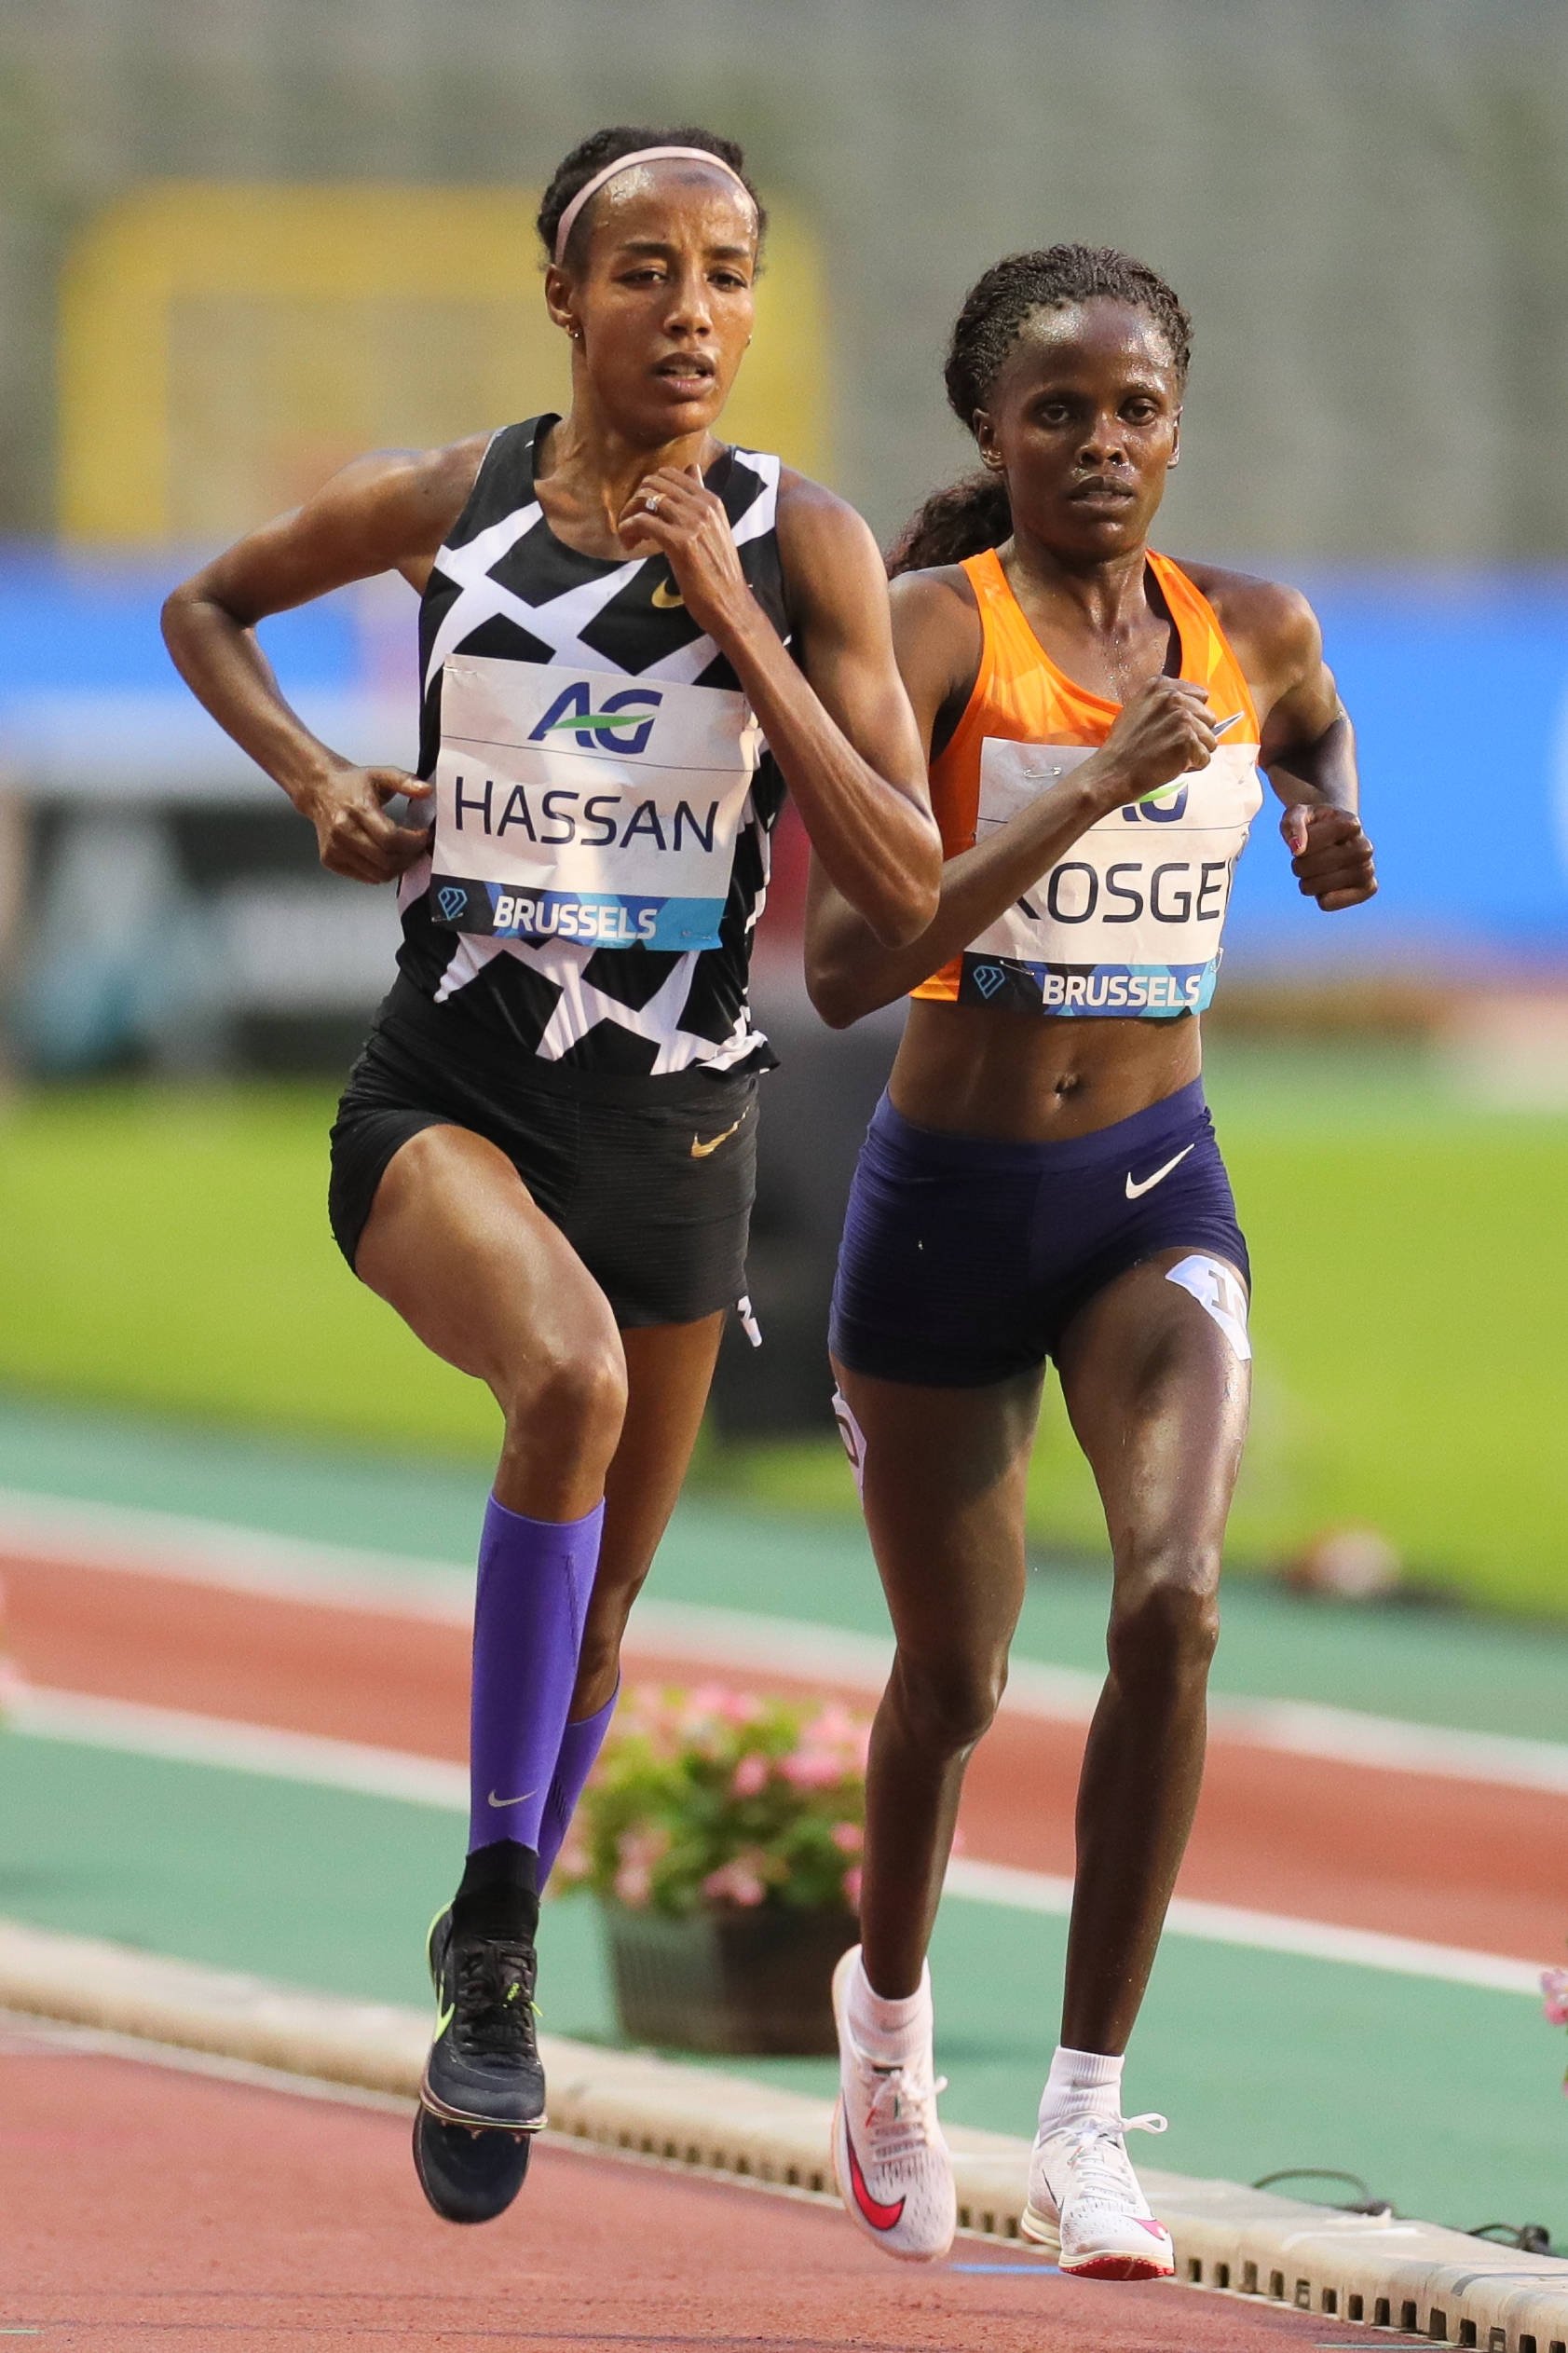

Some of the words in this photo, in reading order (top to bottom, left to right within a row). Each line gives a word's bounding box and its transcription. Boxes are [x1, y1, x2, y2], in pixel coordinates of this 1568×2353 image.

[527, 681, 663, 755] AG
[454, 776, 719, 853] HASSAN
[492, 895, 658, 940] BRUSSELS
[1042, 975, 1202, 1007] BRUSSELS
